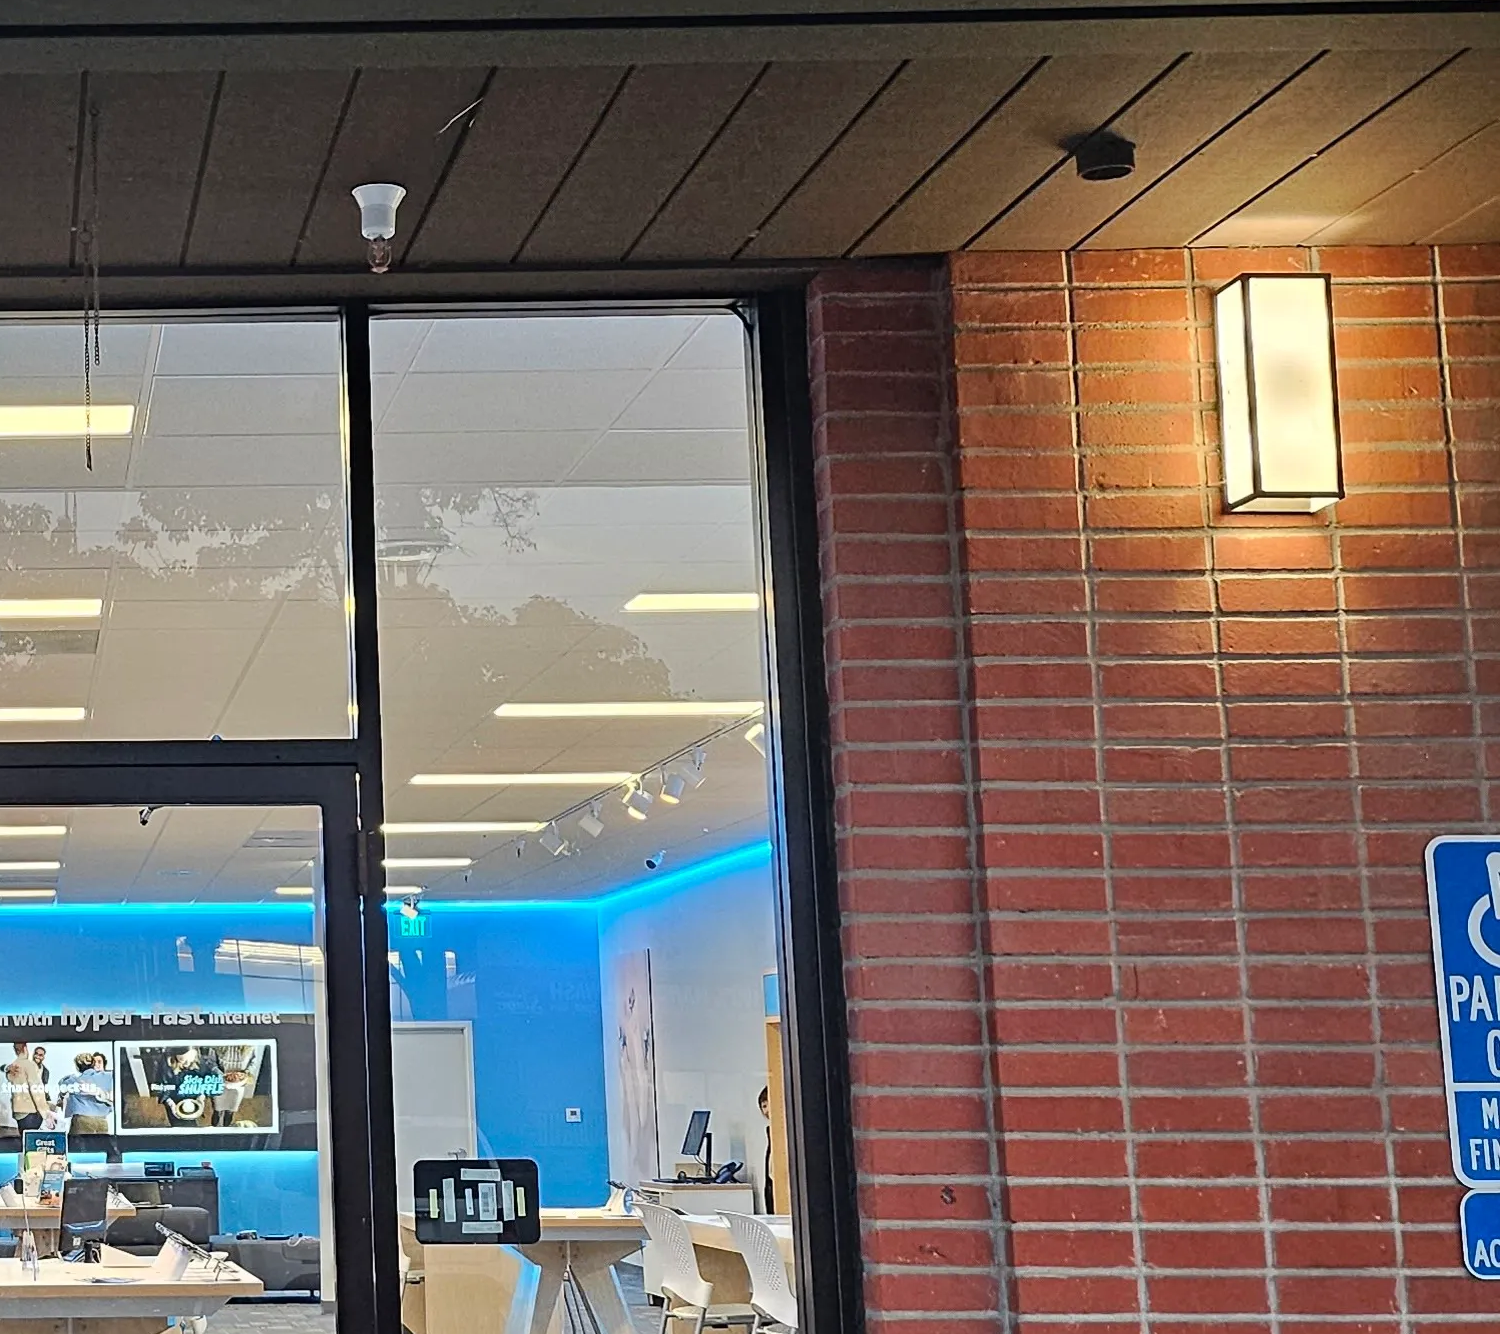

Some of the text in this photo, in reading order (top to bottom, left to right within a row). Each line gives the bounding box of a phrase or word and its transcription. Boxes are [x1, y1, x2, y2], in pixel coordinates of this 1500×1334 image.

[401, 915, 427, 936] EXIT
[12, 1011, 52, 1027] with
[209, 1011, 280, 1026] internet
[2, 1082, 28, 1093] that
[30, 1082, 80, 1094] coect
[179, 1083, 225, 1095] SHUFFLE
